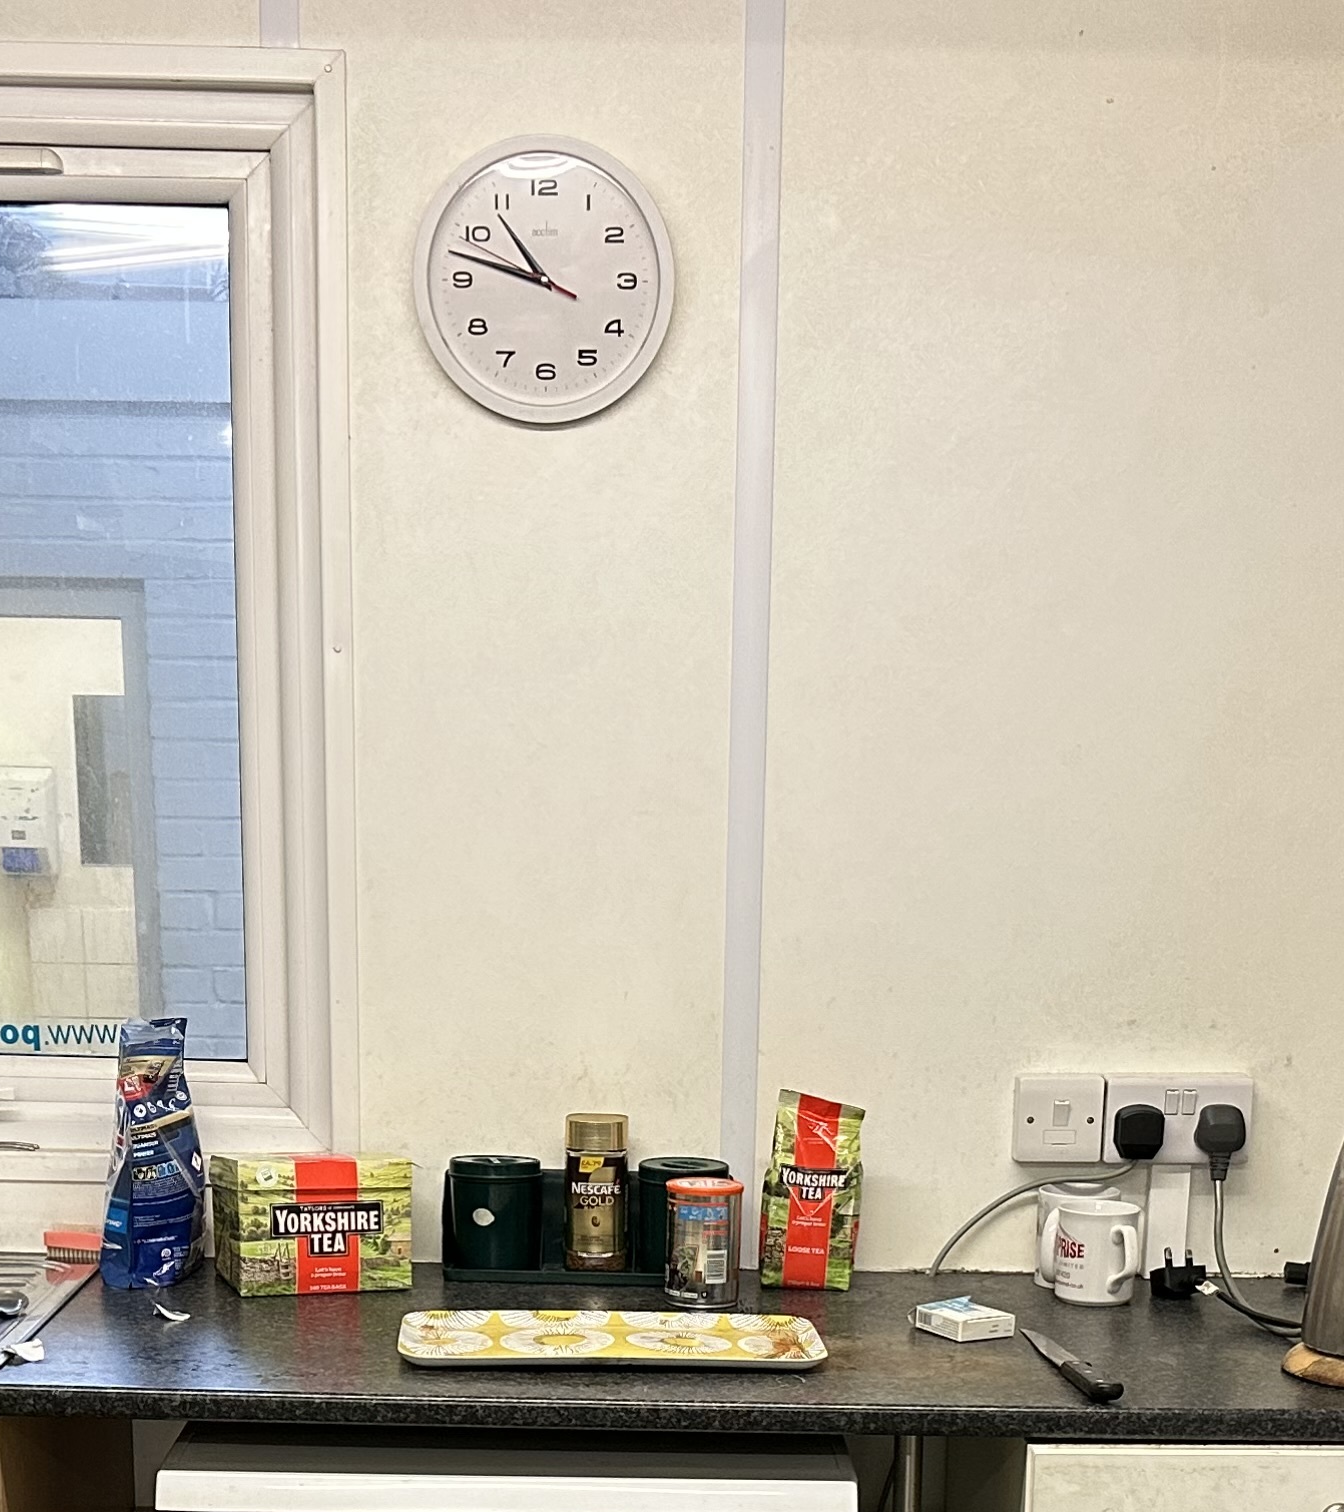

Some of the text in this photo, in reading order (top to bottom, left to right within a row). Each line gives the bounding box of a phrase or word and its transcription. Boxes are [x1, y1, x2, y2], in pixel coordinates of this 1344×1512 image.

[530, 179, 559, 196] 12
[494, 193, 510, 211] 11
[464, 225, 491, 242] 10
[604, 226, 625, 243] 2
[452, 271, 473, 288] 9
[616, 272, 638, 290] 3
[467, 318, 488, 336] 8
[604, 319, 625, 337] 4
[495, 350, 516, 368] 7
[576, 349, 598, 366] 5
[535, 363, 557, 380] 6
[782, 1167, 846, 1188] YORKSHIRE
[571, 1178, 622, 1195] NESCAFÉ
[801, 1187, 822, 1200] TEA
[579, 1195, 615, 1206] GOLD
[275, 1209, 379, 1234] YORKSHIRE
[311, 1233, 345, 1253] TEA
